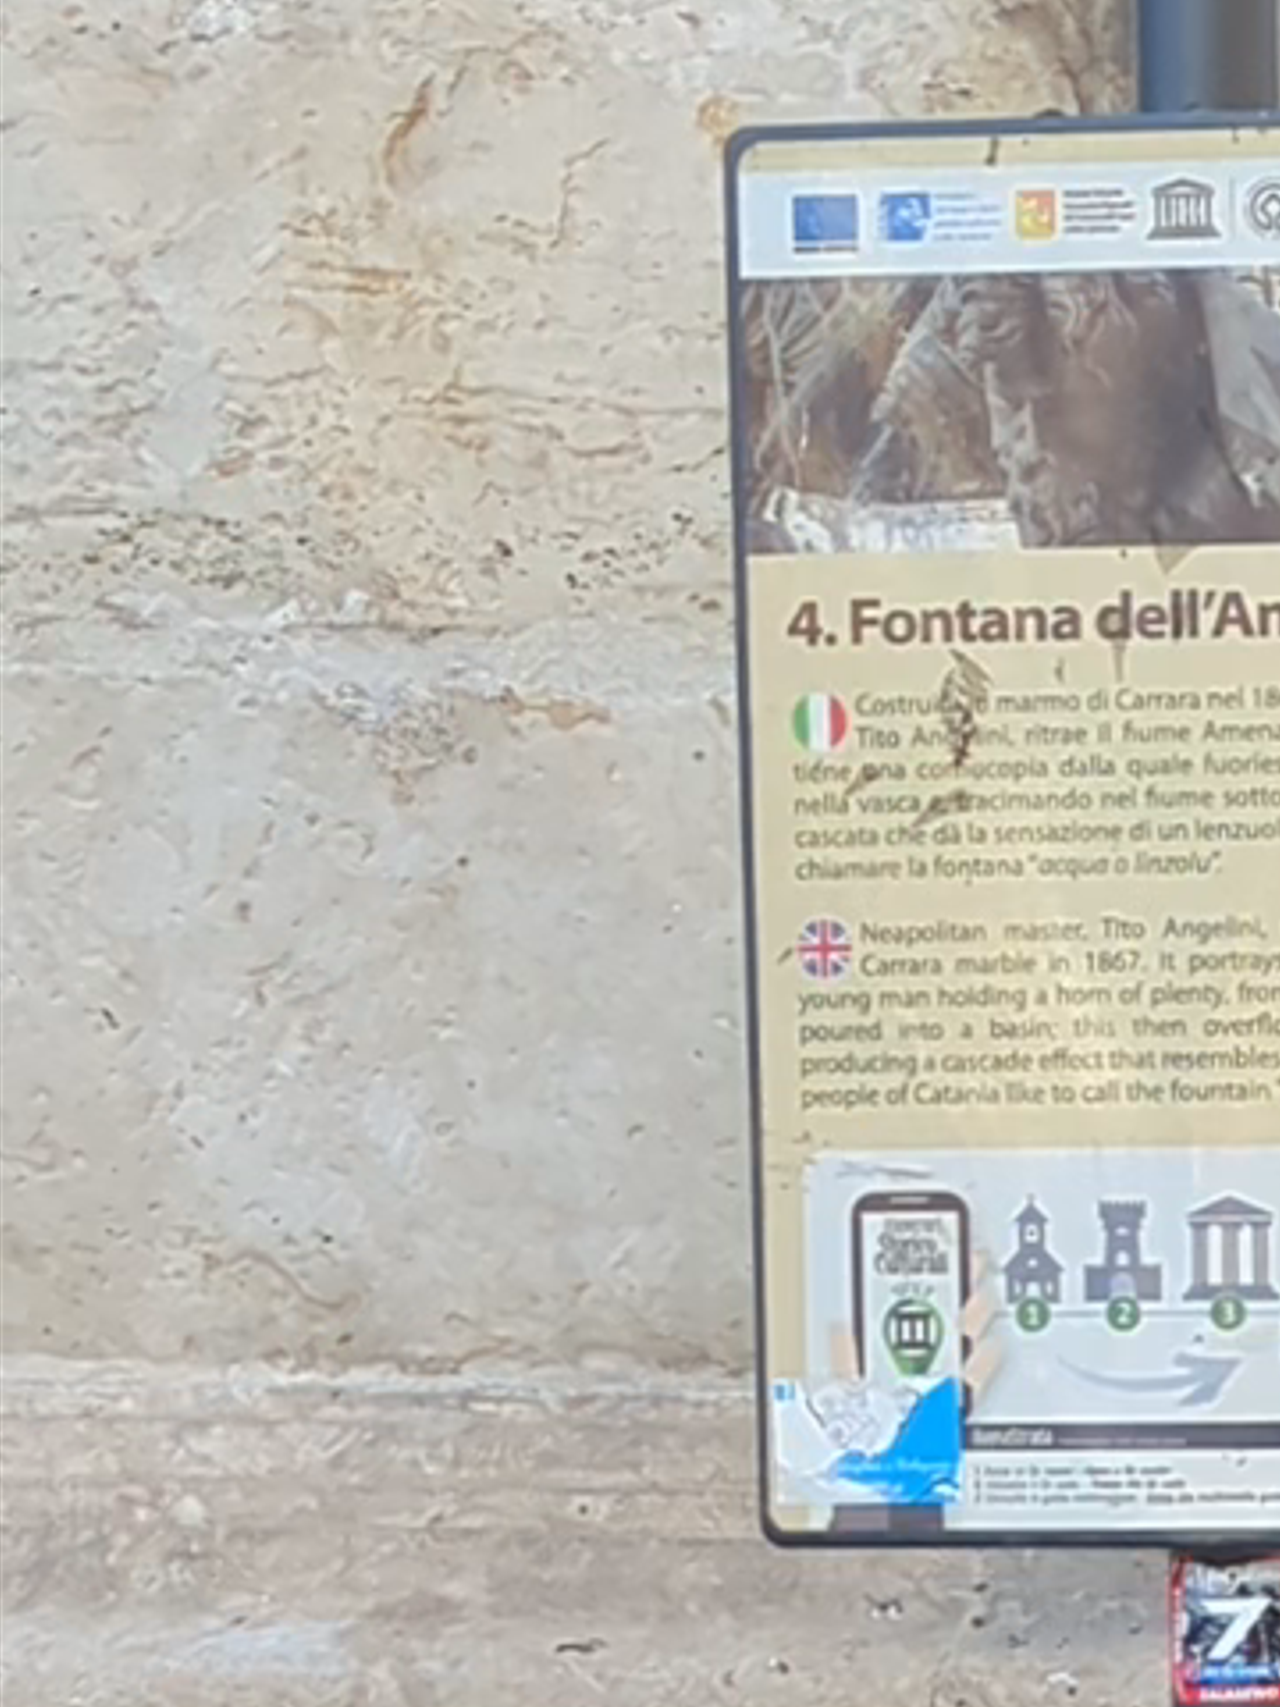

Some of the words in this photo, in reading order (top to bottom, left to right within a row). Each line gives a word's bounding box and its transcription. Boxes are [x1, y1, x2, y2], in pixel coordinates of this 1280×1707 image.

[786, 600, 838, 647] 4.
[850, 597, 1082, 646] Fontana
[996, 695, 1081, 714] marmo
[1086, 689, 1110, 712] di
[1114, 688, 1201, 712] Carrara
[1207, 687, 1244, 711] nel
[854, 724, 900, 748] Tito
[1024, 722, 1087, 746] ritrae
[1097, 722, 1110, 745] il
[1120, 721, 1192, 745] fiume
[793, 758, 852, 782] tiene
[1058, 754, 1116, 778] dalla
[1126, 753, 1194, 783] quale
[793, 791, 849, 815] nella
[856, 796, 921, 814] vasca
[1100, 787, 1138, 810] nel
[1144, 785, 1216, 809] fiume
[794, 824, 879, 846] cascata
[884, 822, 928, 845] che
[933, 821, 962, 845] dà
[967, 821, 987, 844] la
[993, 819, 1123, 844] sensazione
[1128, 819, 1151, 842] di
[1157, 824, 1188, 842] un
[794, 856, 901, 880] chiamare
[907, 856, 928, 879] la
[933, 854, 1024, 879] fontana
[1114, 859, 1129, 876] o
[859, 918, 987, 948] Neapolitan
[1003, 919, 1088, 944] master,
[1099, 916, 1146, 940] Tito
[1161, 915, 1267, 945] Angelini,
[859, 951, 942, 975] Carrara
[954, 950, 1037, 974] marble
[1048, 950, 1071, 973] in
[1085, 949, 1148, 973] 1867.
[1157, 949, 1175, 972] It
[797, 992, 871, 1015] young
[878, 991, 931, 1008] man
[937, 984, 1028, 1014] holding
[1034, 990, 1048, 1007] a
[1054, 983, 1111, 1007] horn
[1118, 983, 1142, 1006] of
[1151, 982, 1230, 1012] plenty,
[800, 1017, 883, 1046] poured
[899, 1016, 944, 1039] into
[960, 1022, 974, 1039] a
[1072, 1014, 1116, 1038] this
[1132, 1014, 1187, 1037] then
[800, 1049, 918, 1079] producing
[923, 1055, 935, 1072] a
[940, 1048, 1034, 1072] cascade
[1038, 1048, 1105, 1071] effect
[1108, 1047, 1155, 1070] that
[800, 1083, 879, 1112] people
[885, 1082, 909, 1105] of
[913, 1081, 1000, 1105] Catania
[1004, 1081, 1047, 1104] like
[1052, 1083, 1076, 1104] to
[1081, 1080, 1119, 1104] call
[1125, 1080, 1165, 1103] the
[1170, 1079, 1272, 1103] fountain
